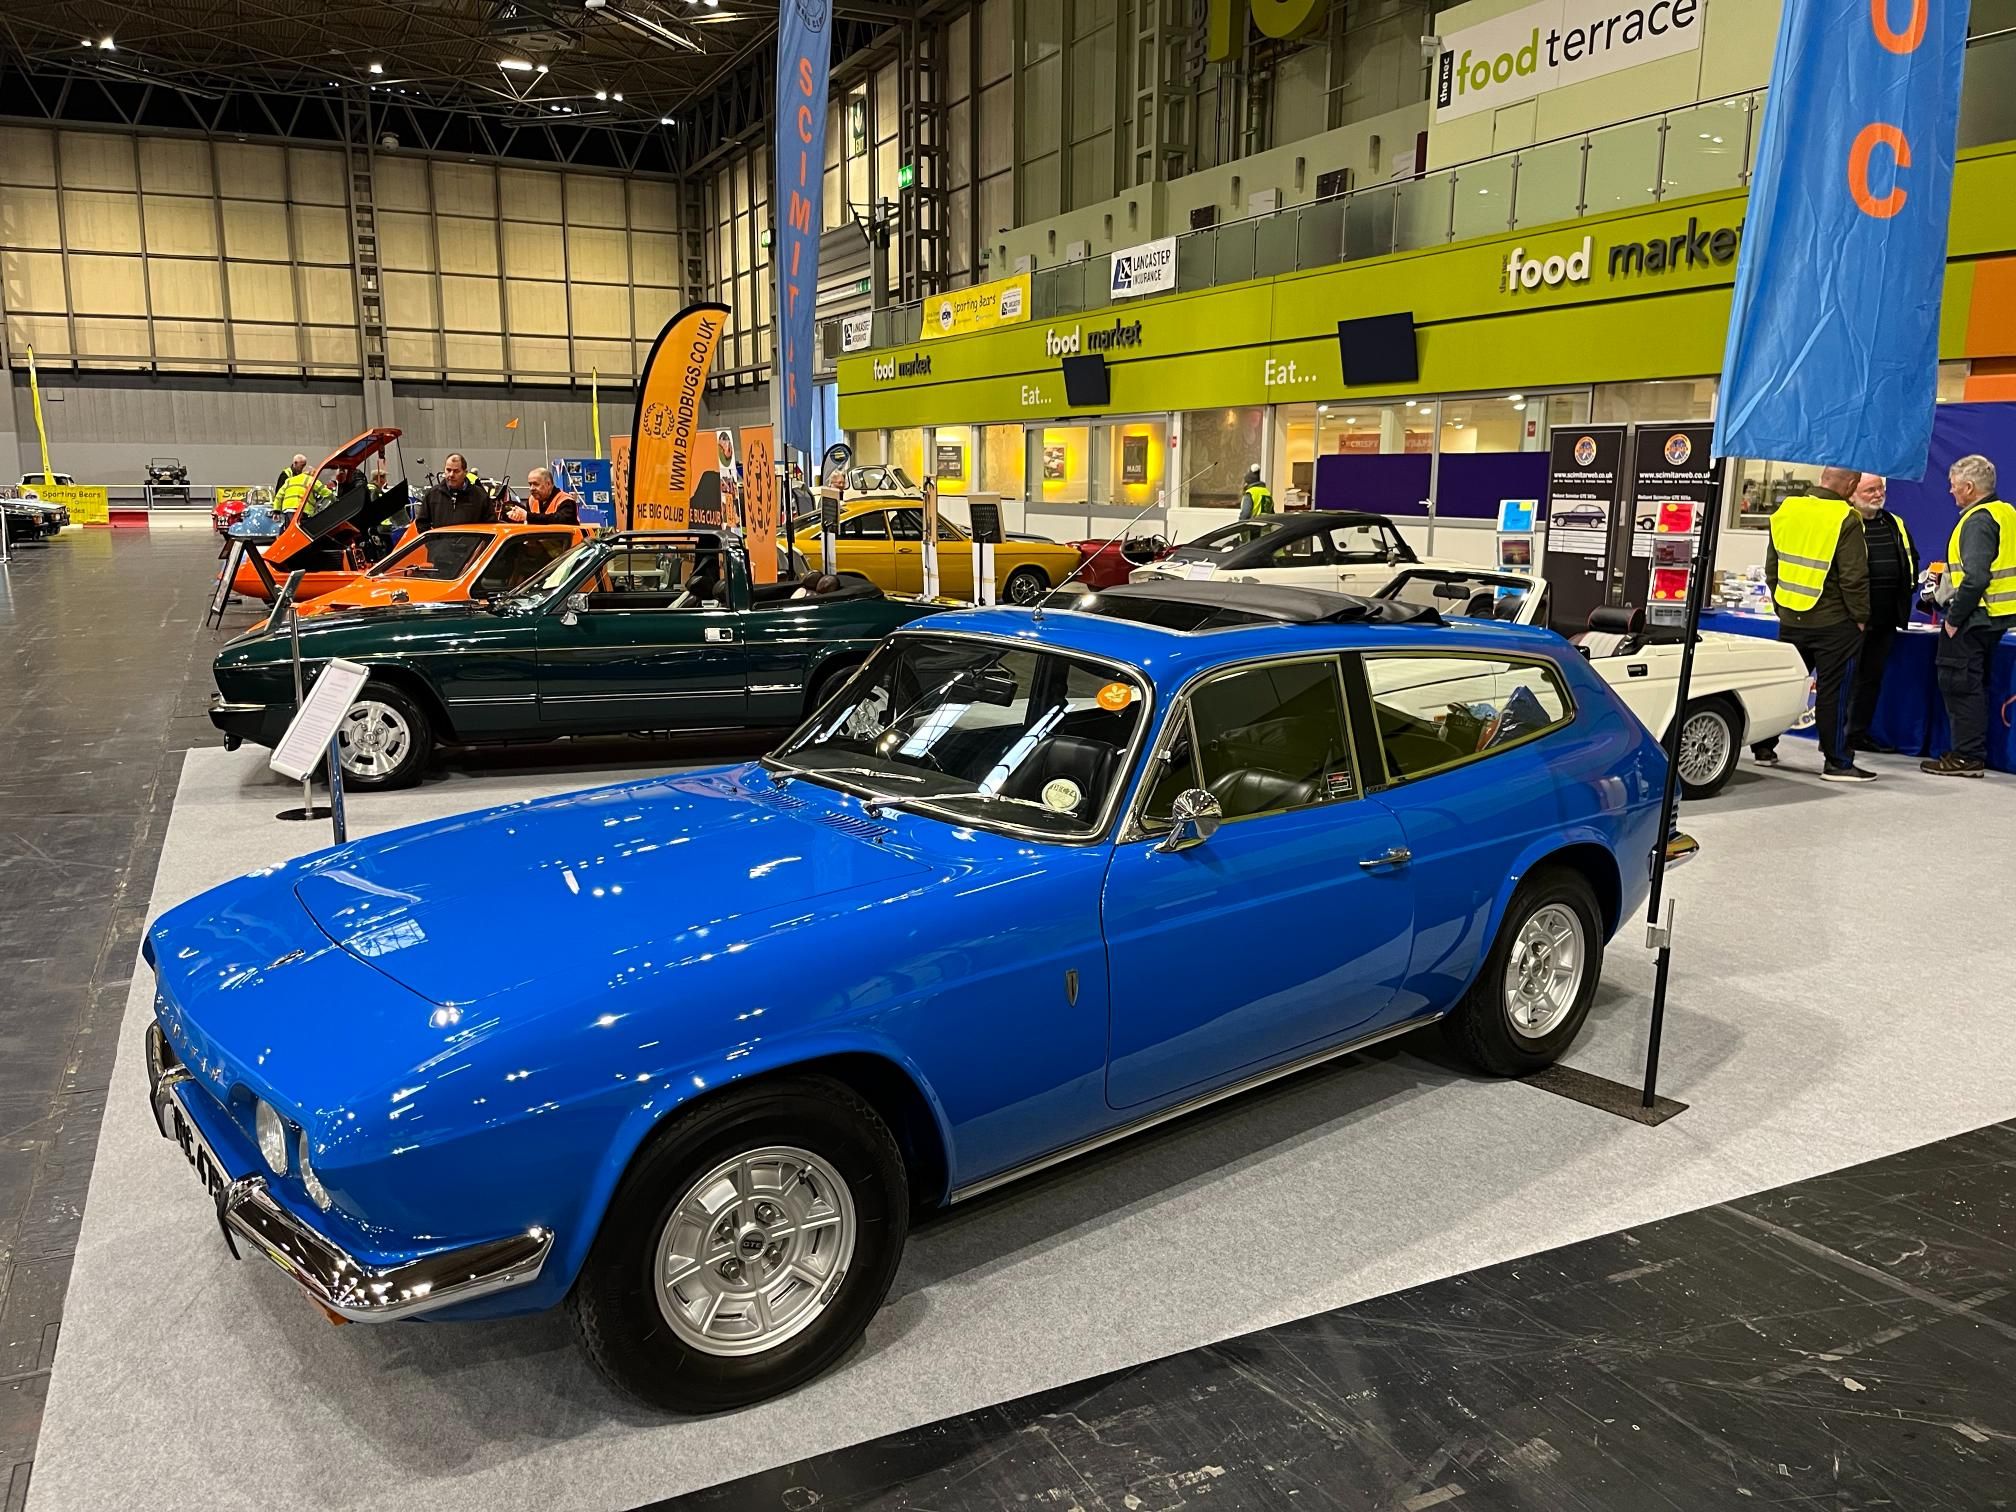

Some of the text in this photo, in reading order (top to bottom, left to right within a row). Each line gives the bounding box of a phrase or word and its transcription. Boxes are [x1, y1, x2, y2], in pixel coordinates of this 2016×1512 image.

[1456, 0, 1698, 96] food terrace
[1439, 57, 1451, 103] the nec
[1133, 249, 1171, 272] LANCASTER
[1507, 236, 1593, 291] food
[953, 294, 996, 314] Sporting Bears
[1046, 319, 1142, 356] food market
[873, 353, 931, 380] food market
[1264, 359, 1317, 386] Eat...
[669, 317, 717, 491] WWW.BONDBUGS.CO.UK
[1021, 385, 1052, 406] Eat...
[1554, 471, 1613, 479] www.scimitarweb.co.uk
[1639, 470, 1711, 480] www.scimitarweb.co.uk
[43, 490, 101, 500] Sporting Bears
[663, 505, 684, 522] CLUB
